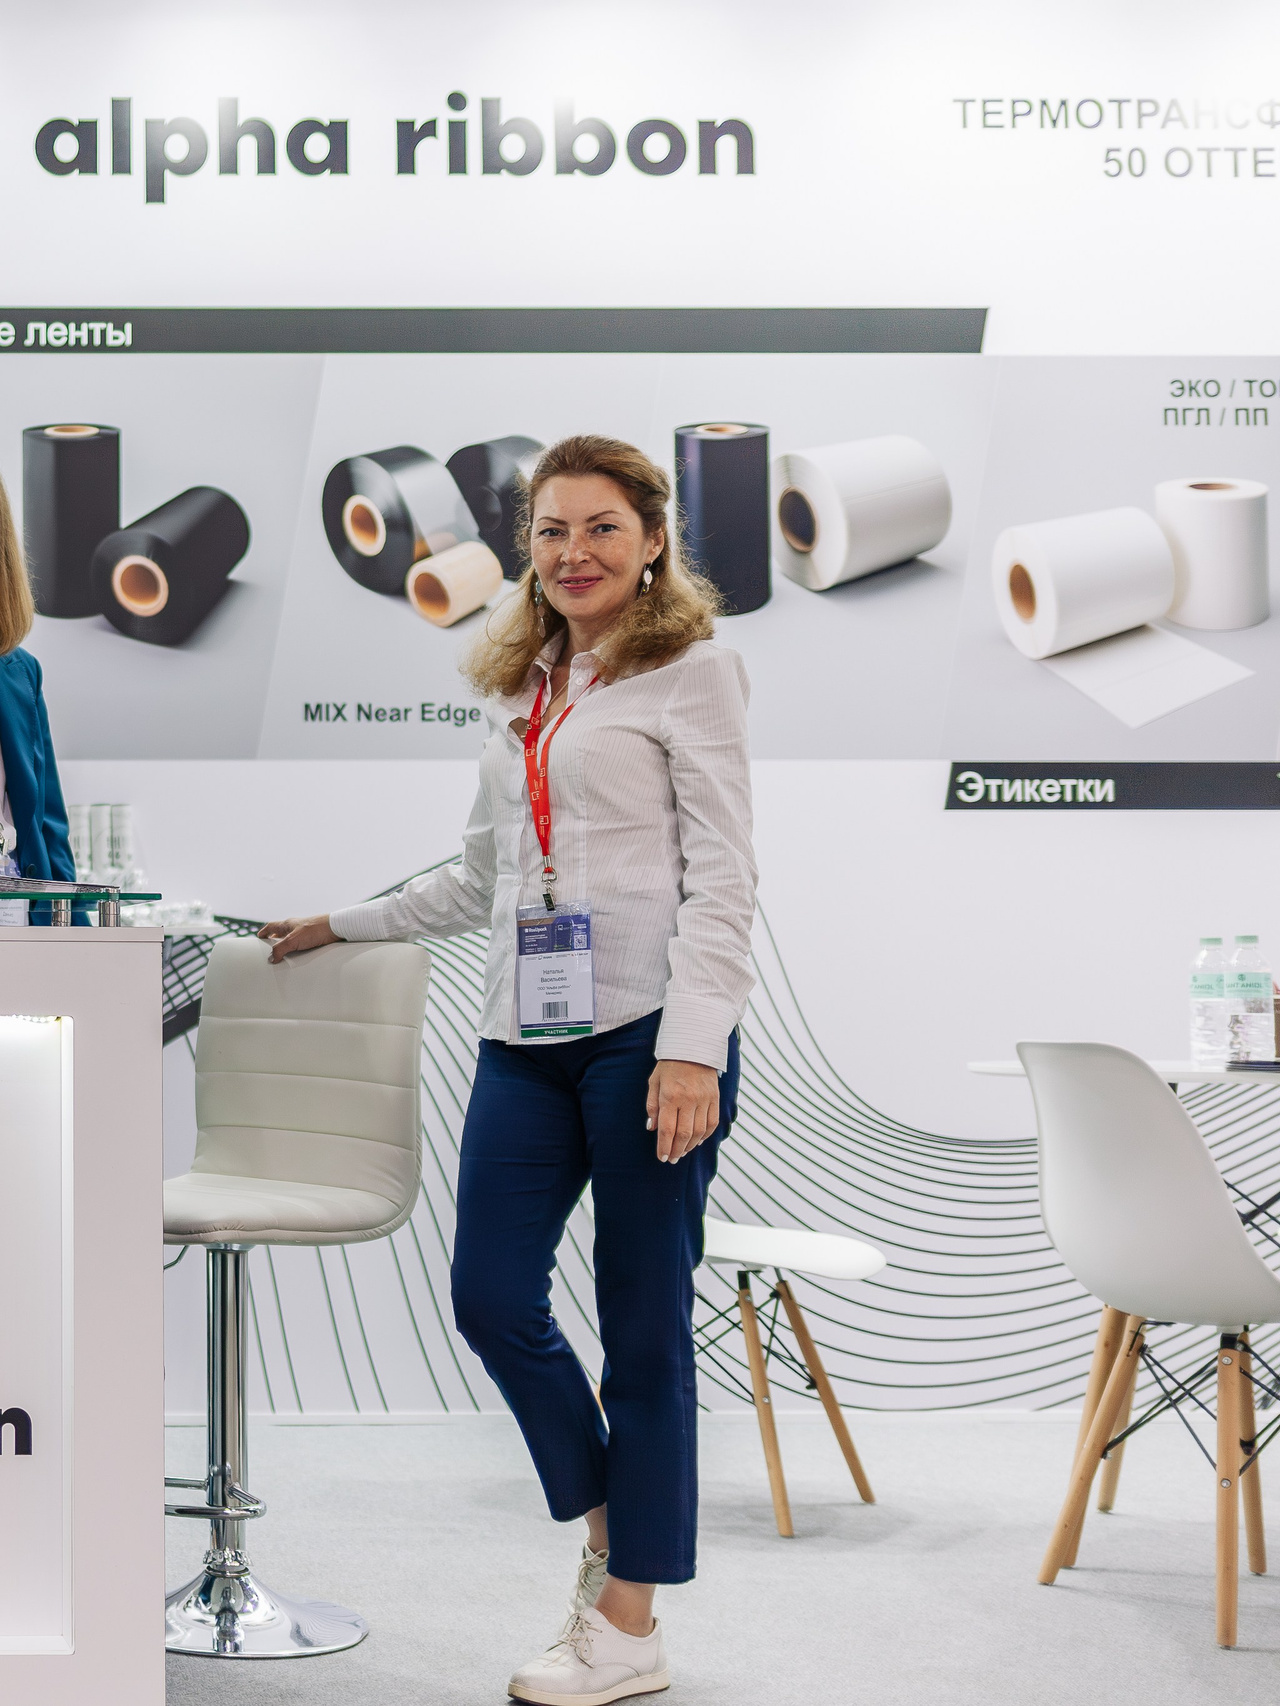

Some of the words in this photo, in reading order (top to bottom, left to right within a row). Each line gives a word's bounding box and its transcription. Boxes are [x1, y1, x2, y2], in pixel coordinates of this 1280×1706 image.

[34, 97, 350, 204] alpha
[395, 90, 757, 176] ribbon
[1103, 147, 1147, 178] 50
[1163, 147, 1278, 178] ОТТЕ
[22, 320, 133, 349] ленты
[1169, 378, 1221, 398] ЭКО
[1243, 378, 1280, 398] ТО
[1163, 407, 1211, 426] ПГЛ
[1234, 407, 1269, 426] ПП
[303, 702, 348, 722] MIX
[356, 702, 412, 722] Near
[420, 702, 482, 727] Edge
[954, 770, 1116, 803] Этикетки
